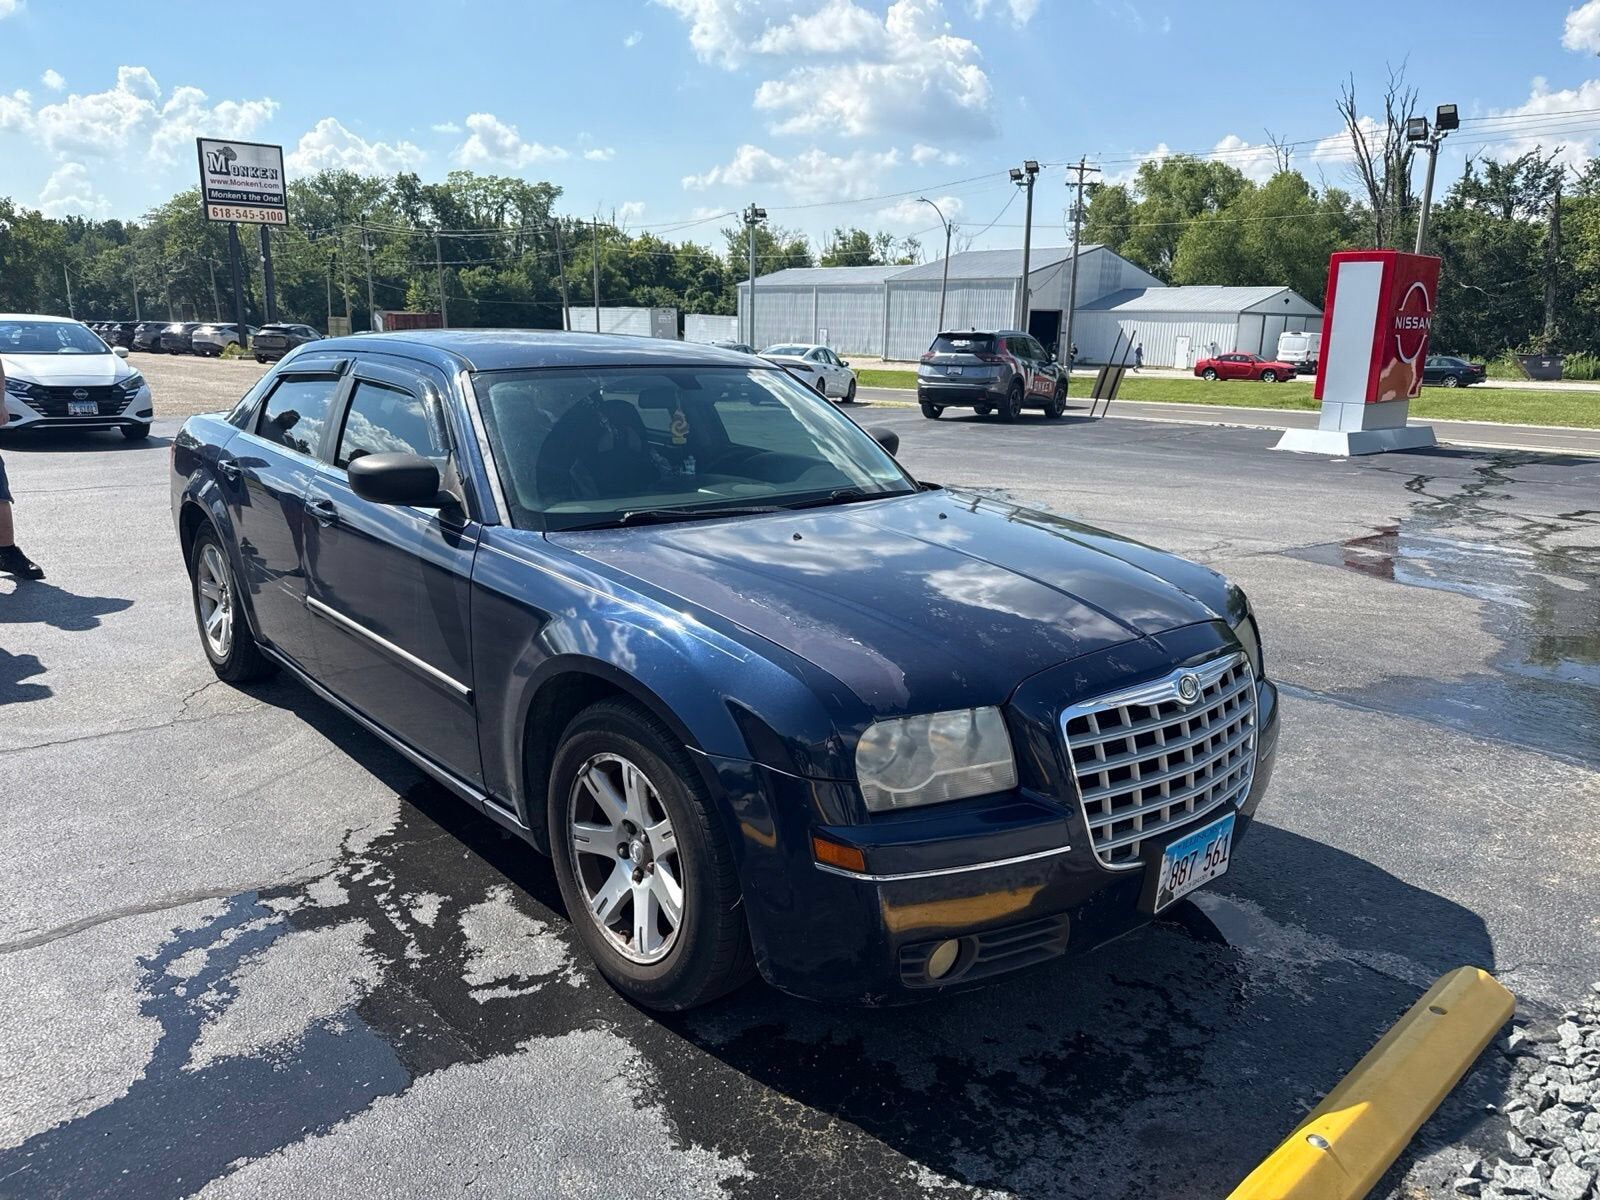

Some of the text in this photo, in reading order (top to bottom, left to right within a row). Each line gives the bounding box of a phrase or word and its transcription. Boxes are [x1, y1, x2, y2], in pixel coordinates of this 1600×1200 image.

[210, 178, 279, 189] www.Monken1.com
[210, 190, 281, 203] Monken's the One!
[212, 207, 283, 221] 618-545-5100
[1395, 316, 1431, 329] NISSAN
[1169, 850, 1198, 891] 887
[1203, 834, 1228, 872] 561
